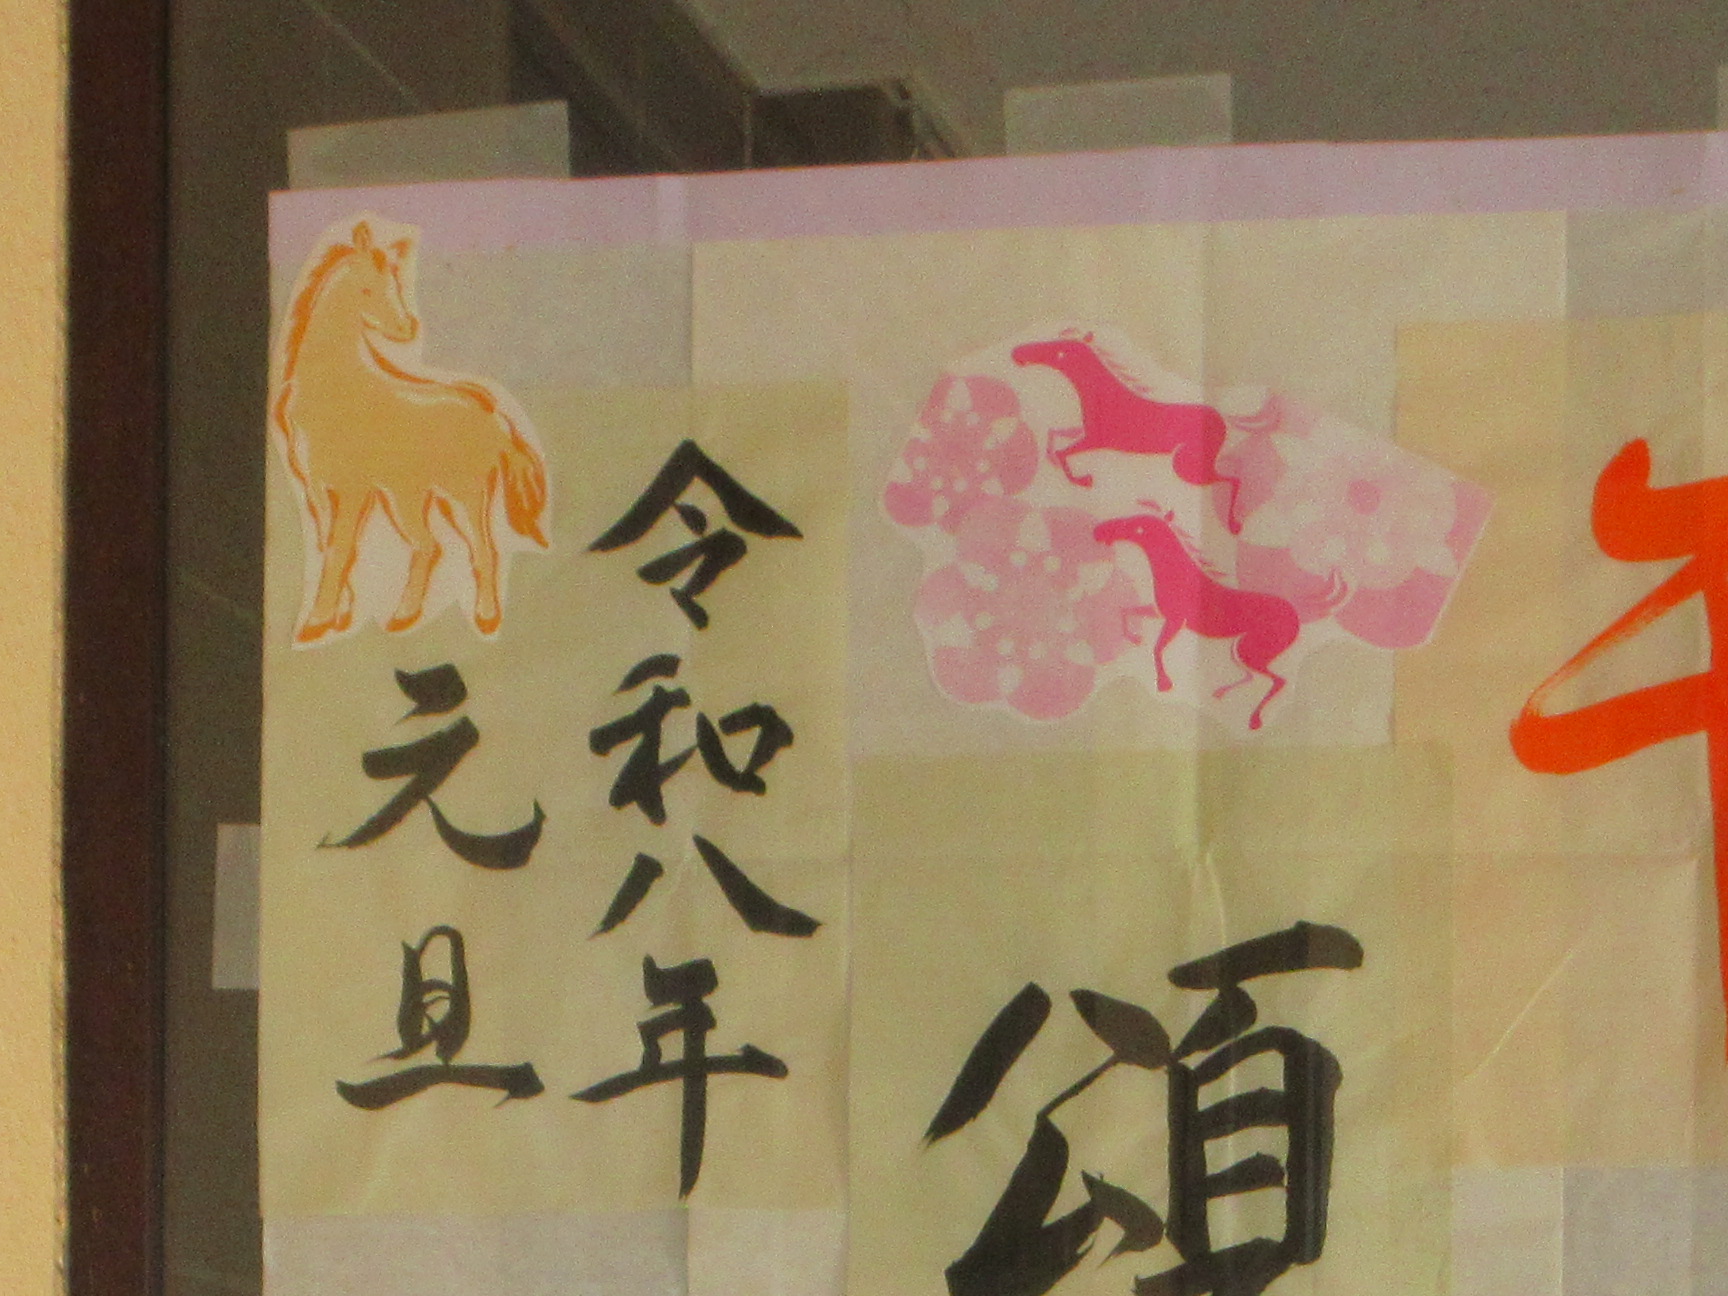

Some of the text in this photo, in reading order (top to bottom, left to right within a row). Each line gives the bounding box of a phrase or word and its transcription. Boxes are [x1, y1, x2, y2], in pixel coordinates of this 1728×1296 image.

[318, 663, 546, 1112] 元旦
[571, 438, 822, 1199] 令和八年
